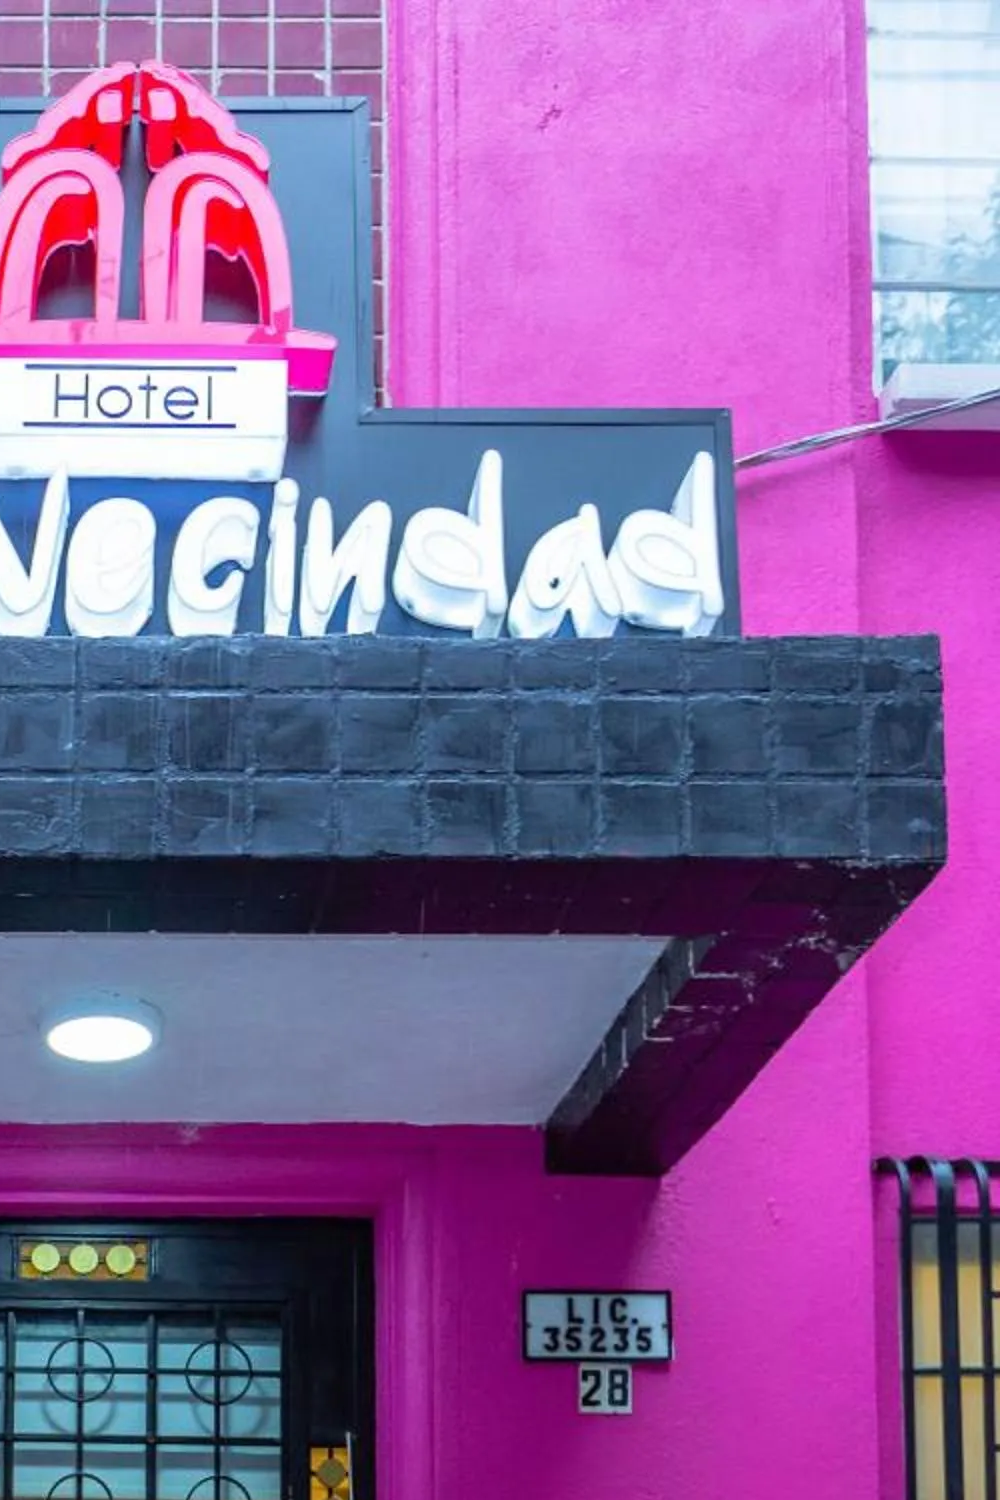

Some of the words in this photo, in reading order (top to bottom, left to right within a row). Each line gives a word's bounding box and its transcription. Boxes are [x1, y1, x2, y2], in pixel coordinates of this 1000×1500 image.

[53, 373, 213, 420] Hotel
[566, 1297, 639, 1325] LIC.
[543, 1327, 653, 1352] 35235
[581, 1369, 629, 1406] 28
